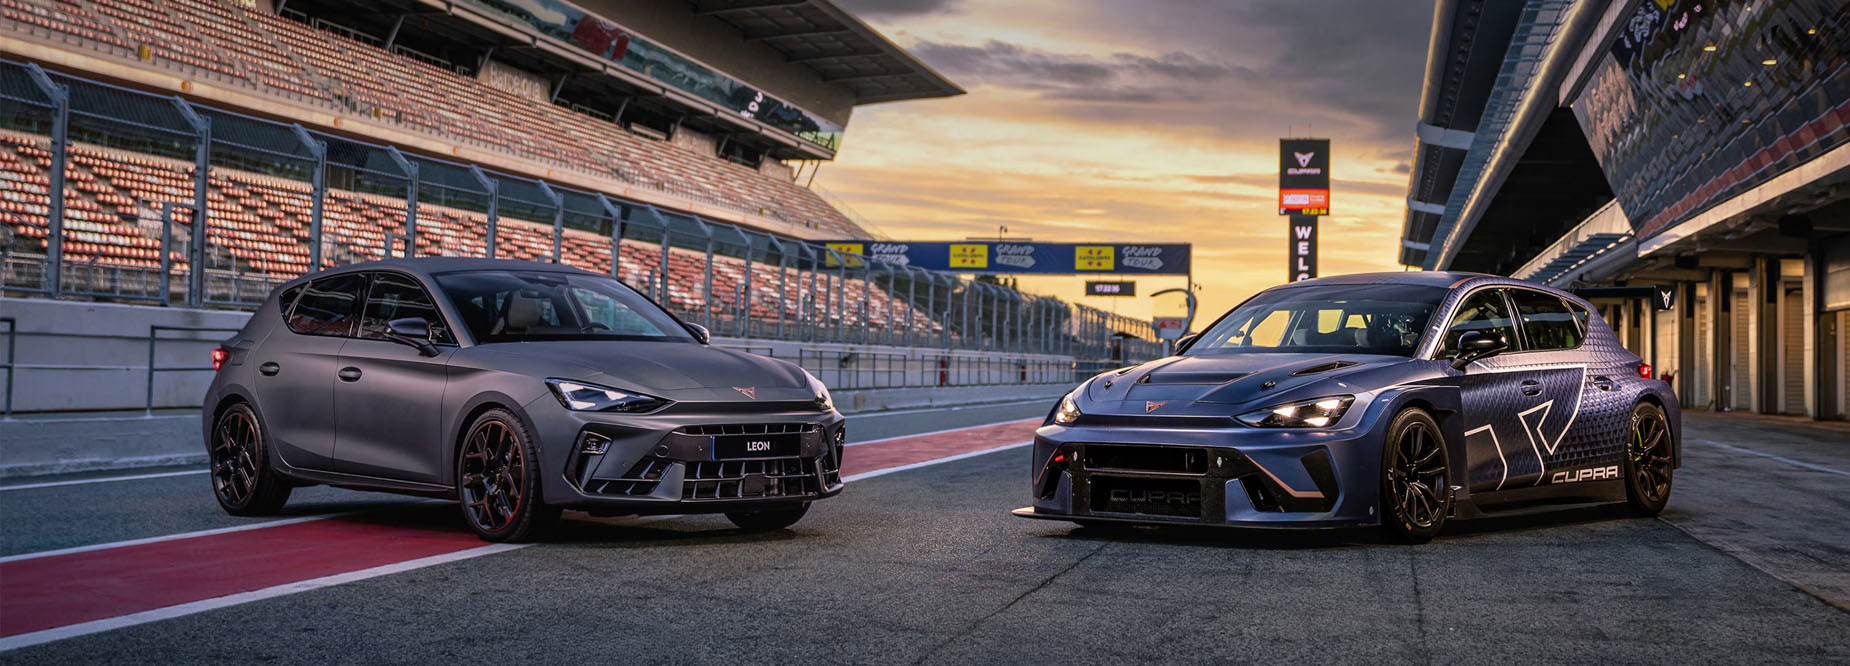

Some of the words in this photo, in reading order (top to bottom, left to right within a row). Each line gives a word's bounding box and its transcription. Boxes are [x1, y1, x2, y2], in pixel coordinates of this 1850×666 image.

[1287, 167, 1321, 175] CUPRA
[870, 243, 909, 254] GRAND
[995, 243, 1035, 256] GRAND
[1122, 246, 1162, 257] GRAND
[1128, 257, 1155, 267] TOUR
[746, 441, 770, 451] LEON
[1551, 465, 1618, 484] CUPRA
